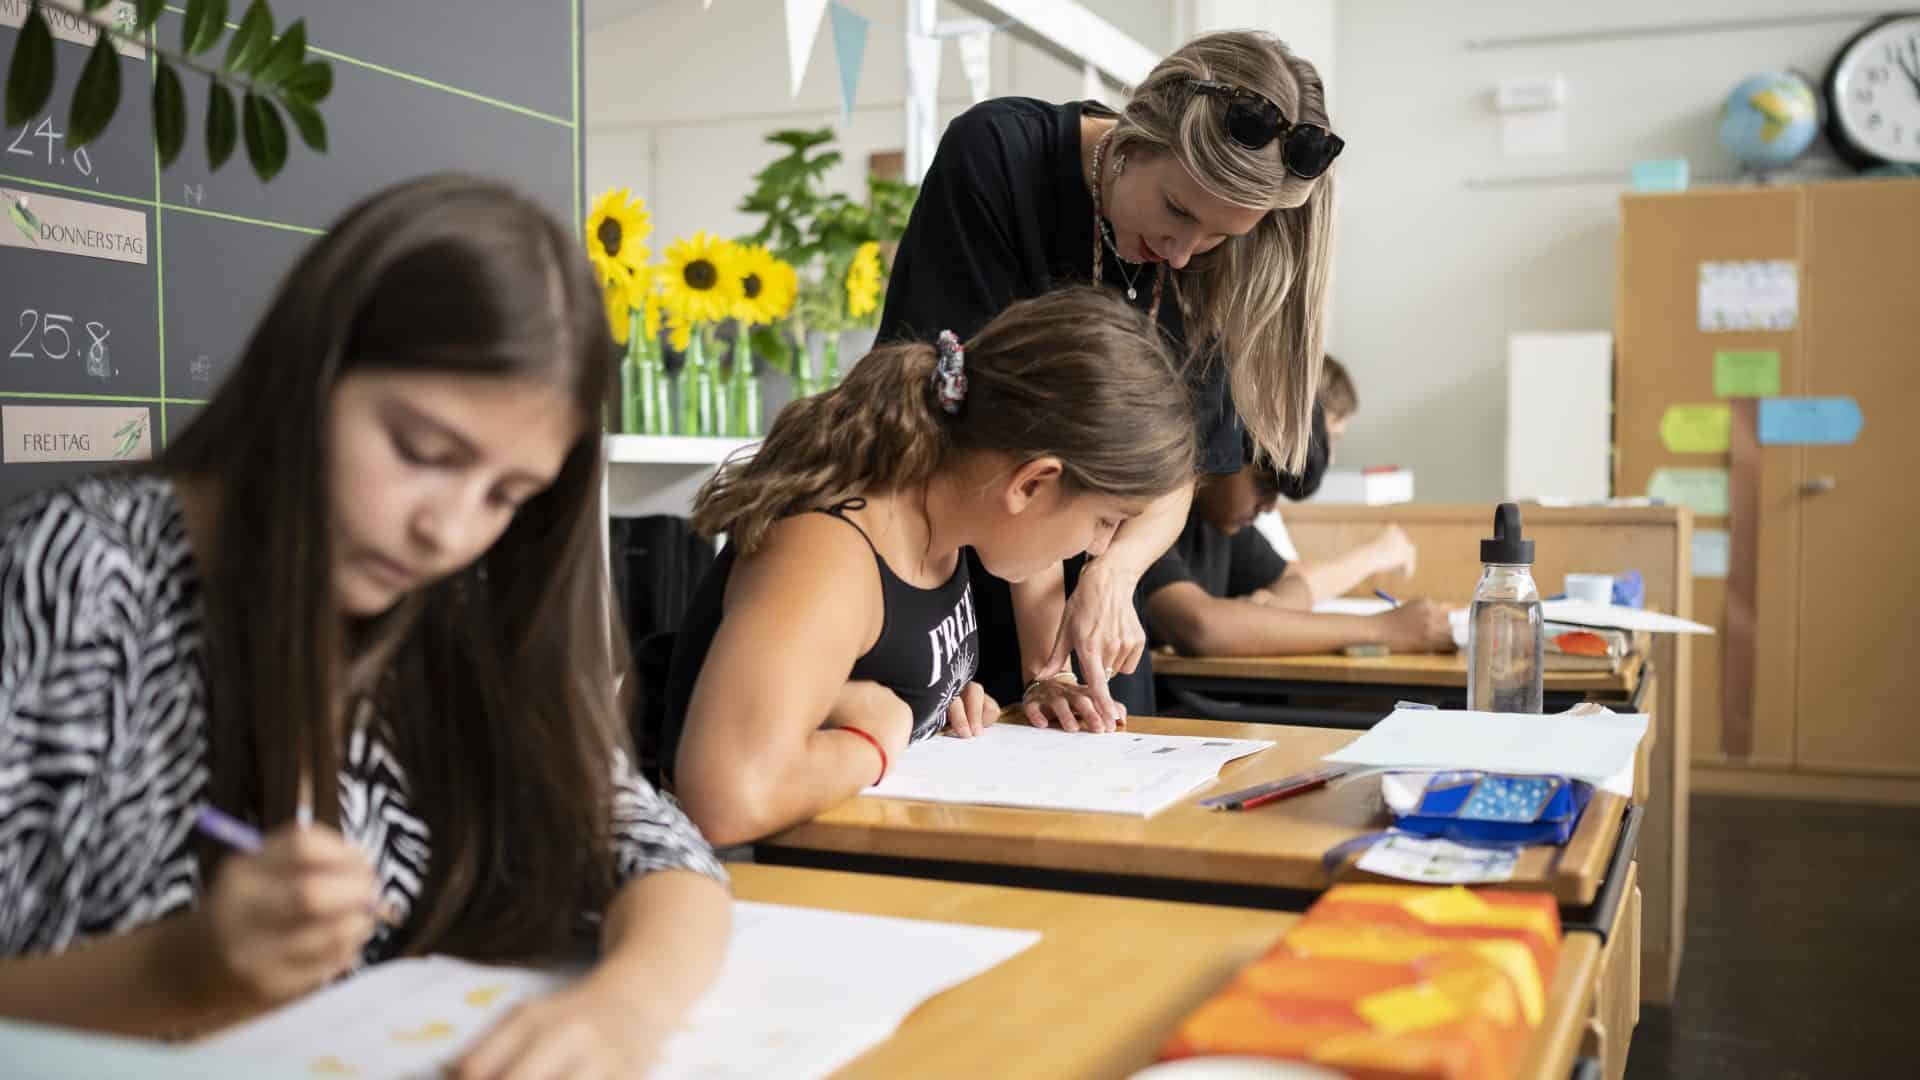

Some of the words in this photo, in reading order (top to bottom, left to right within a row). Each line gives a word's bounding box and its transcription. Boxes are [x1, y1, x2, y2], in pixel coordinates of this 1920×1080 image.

[40, 223, 144, 254] DONNERSTAG
[9, 309, 119, 376] 25.8.
[23, 433, 90, 452] FREITAG
